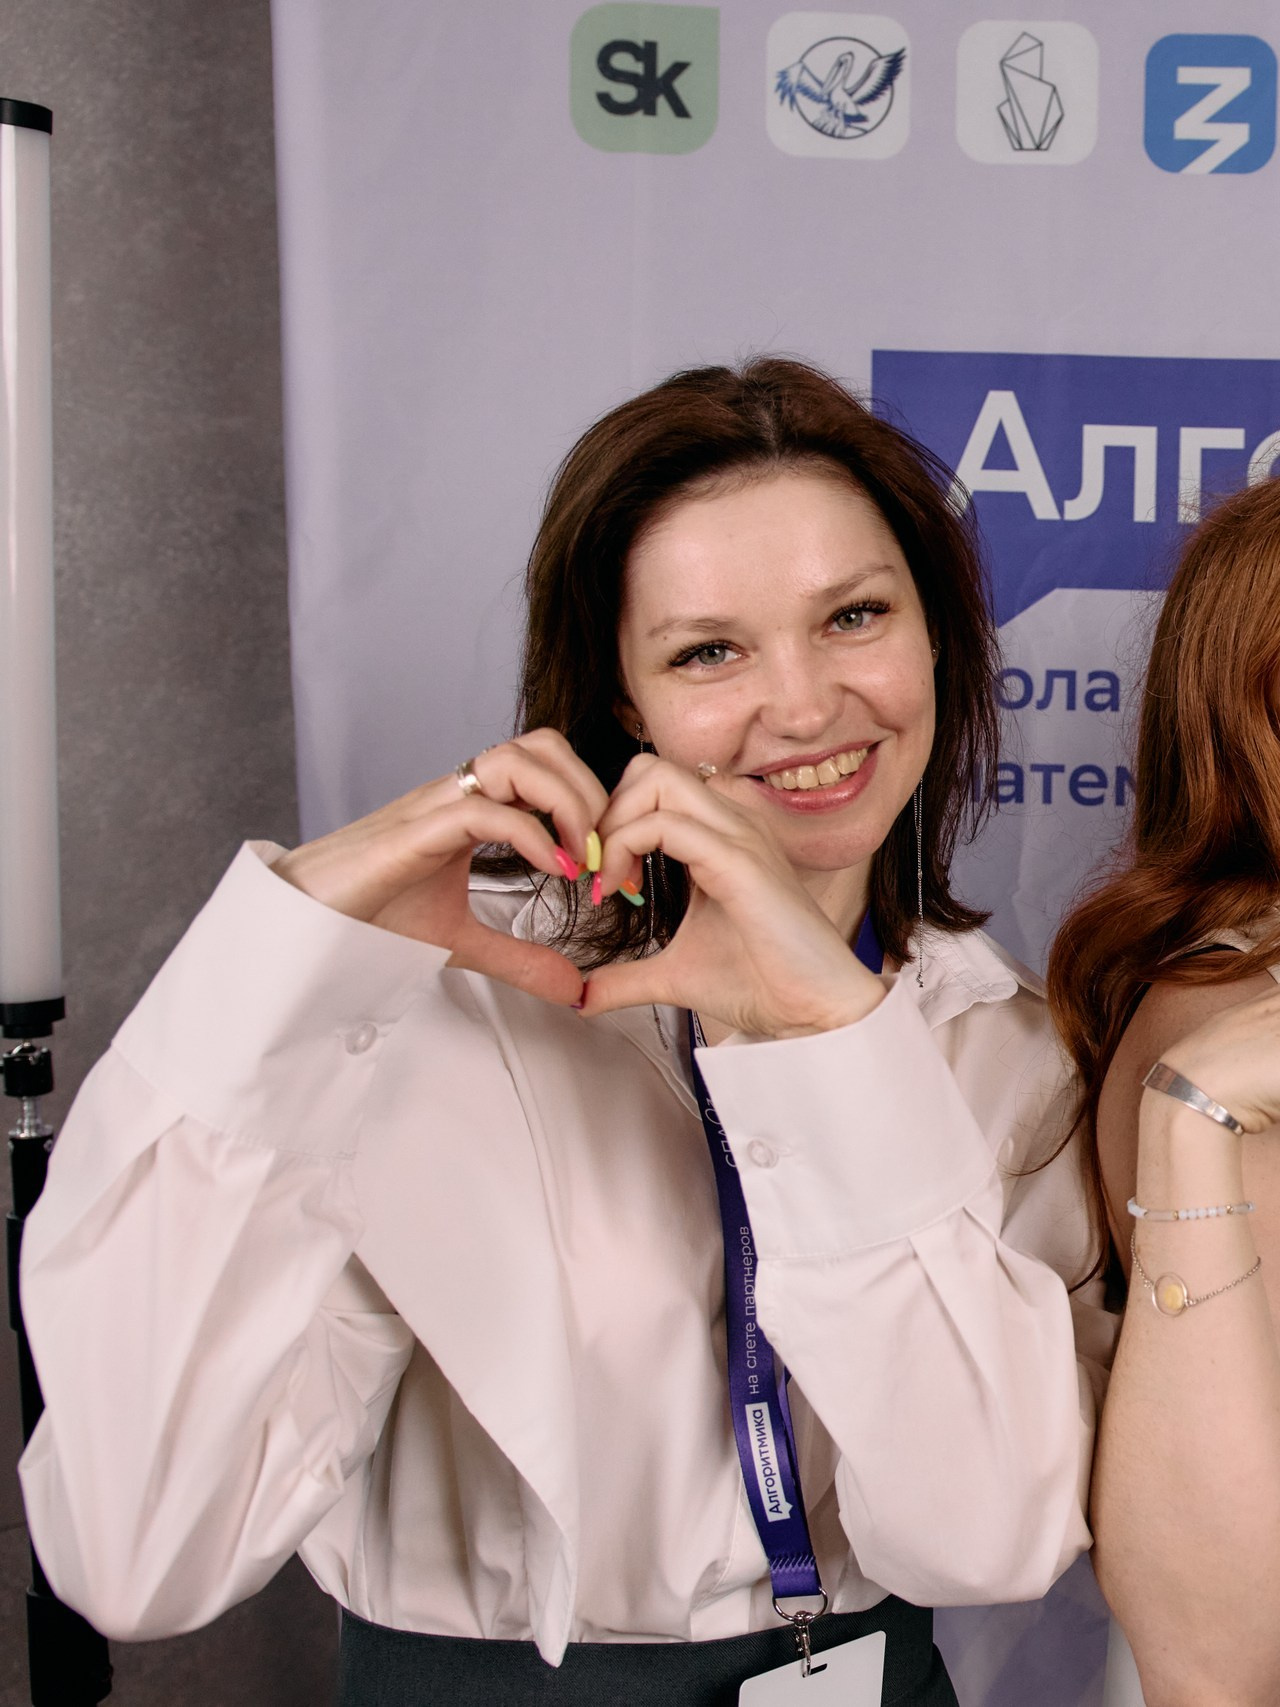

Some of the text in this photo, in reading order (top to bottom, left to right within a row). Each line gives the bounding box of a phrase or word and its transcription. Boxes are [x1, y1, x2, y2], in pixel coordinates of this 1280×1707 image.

[595, 39, 692, 119] Sk
[740, 1226, 783, 1514] Алгоритмика на слете партнеров
